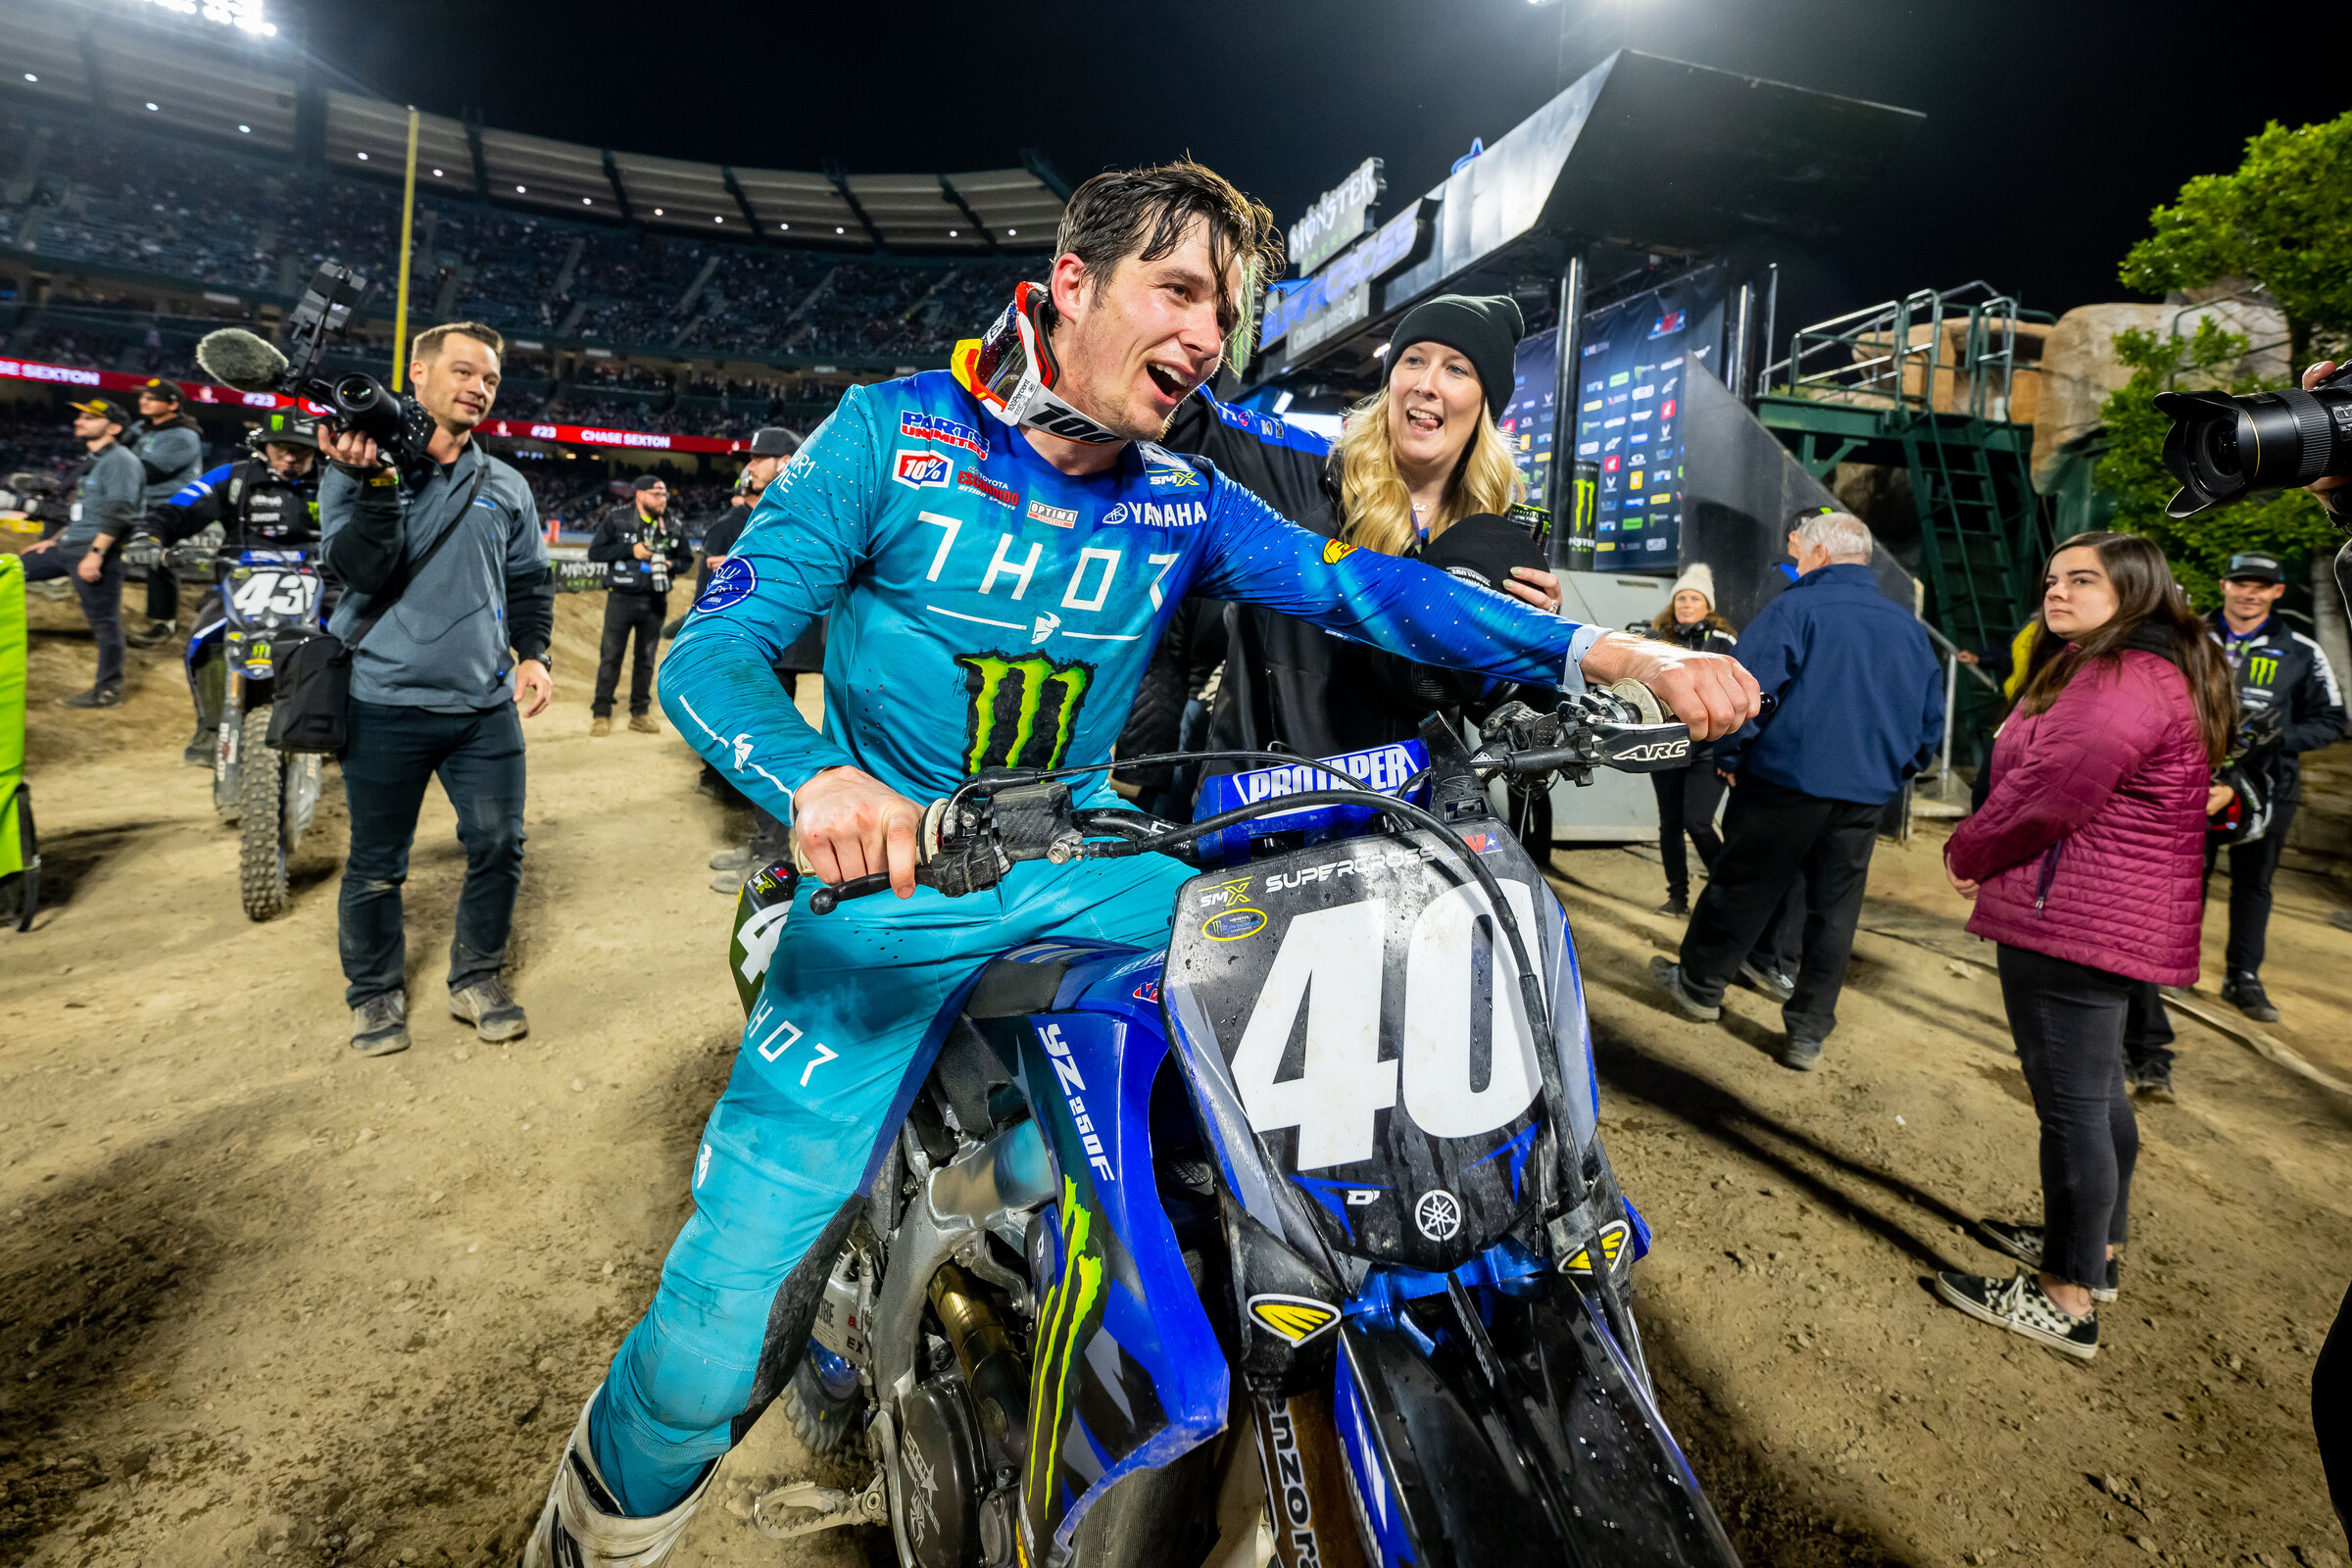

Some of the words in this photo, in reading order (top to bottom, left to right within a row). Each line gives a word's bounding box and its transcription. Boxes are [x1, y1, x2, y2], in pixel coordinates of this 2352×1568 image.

[1290, 161, 1376, 258] MONSTER
[21, 364, 101, 386] SEXTON
[530, 425, 557, 439] #23
[581, 429, 622, 444] CHASE
[623, 433, 671, 449] SEXTON
[902, 410, 991, 454] PARTS
[979, 471, 1009, 490] TOYOTA
[1031, 502, 1074, 522] OPTIMA
[1128, 501, 1207, 528] YAMAHA
[231, 572, 318, 616] 43
[1612, 740, 1690, 761] ARC
[1249, 748, 1408, 804] PROTAPER
[1265, 845, 1436, 893] SUPERCROSS
[1200, 881, 1251, 908] SMX
[1230, 877, 1544, 1172] 40
